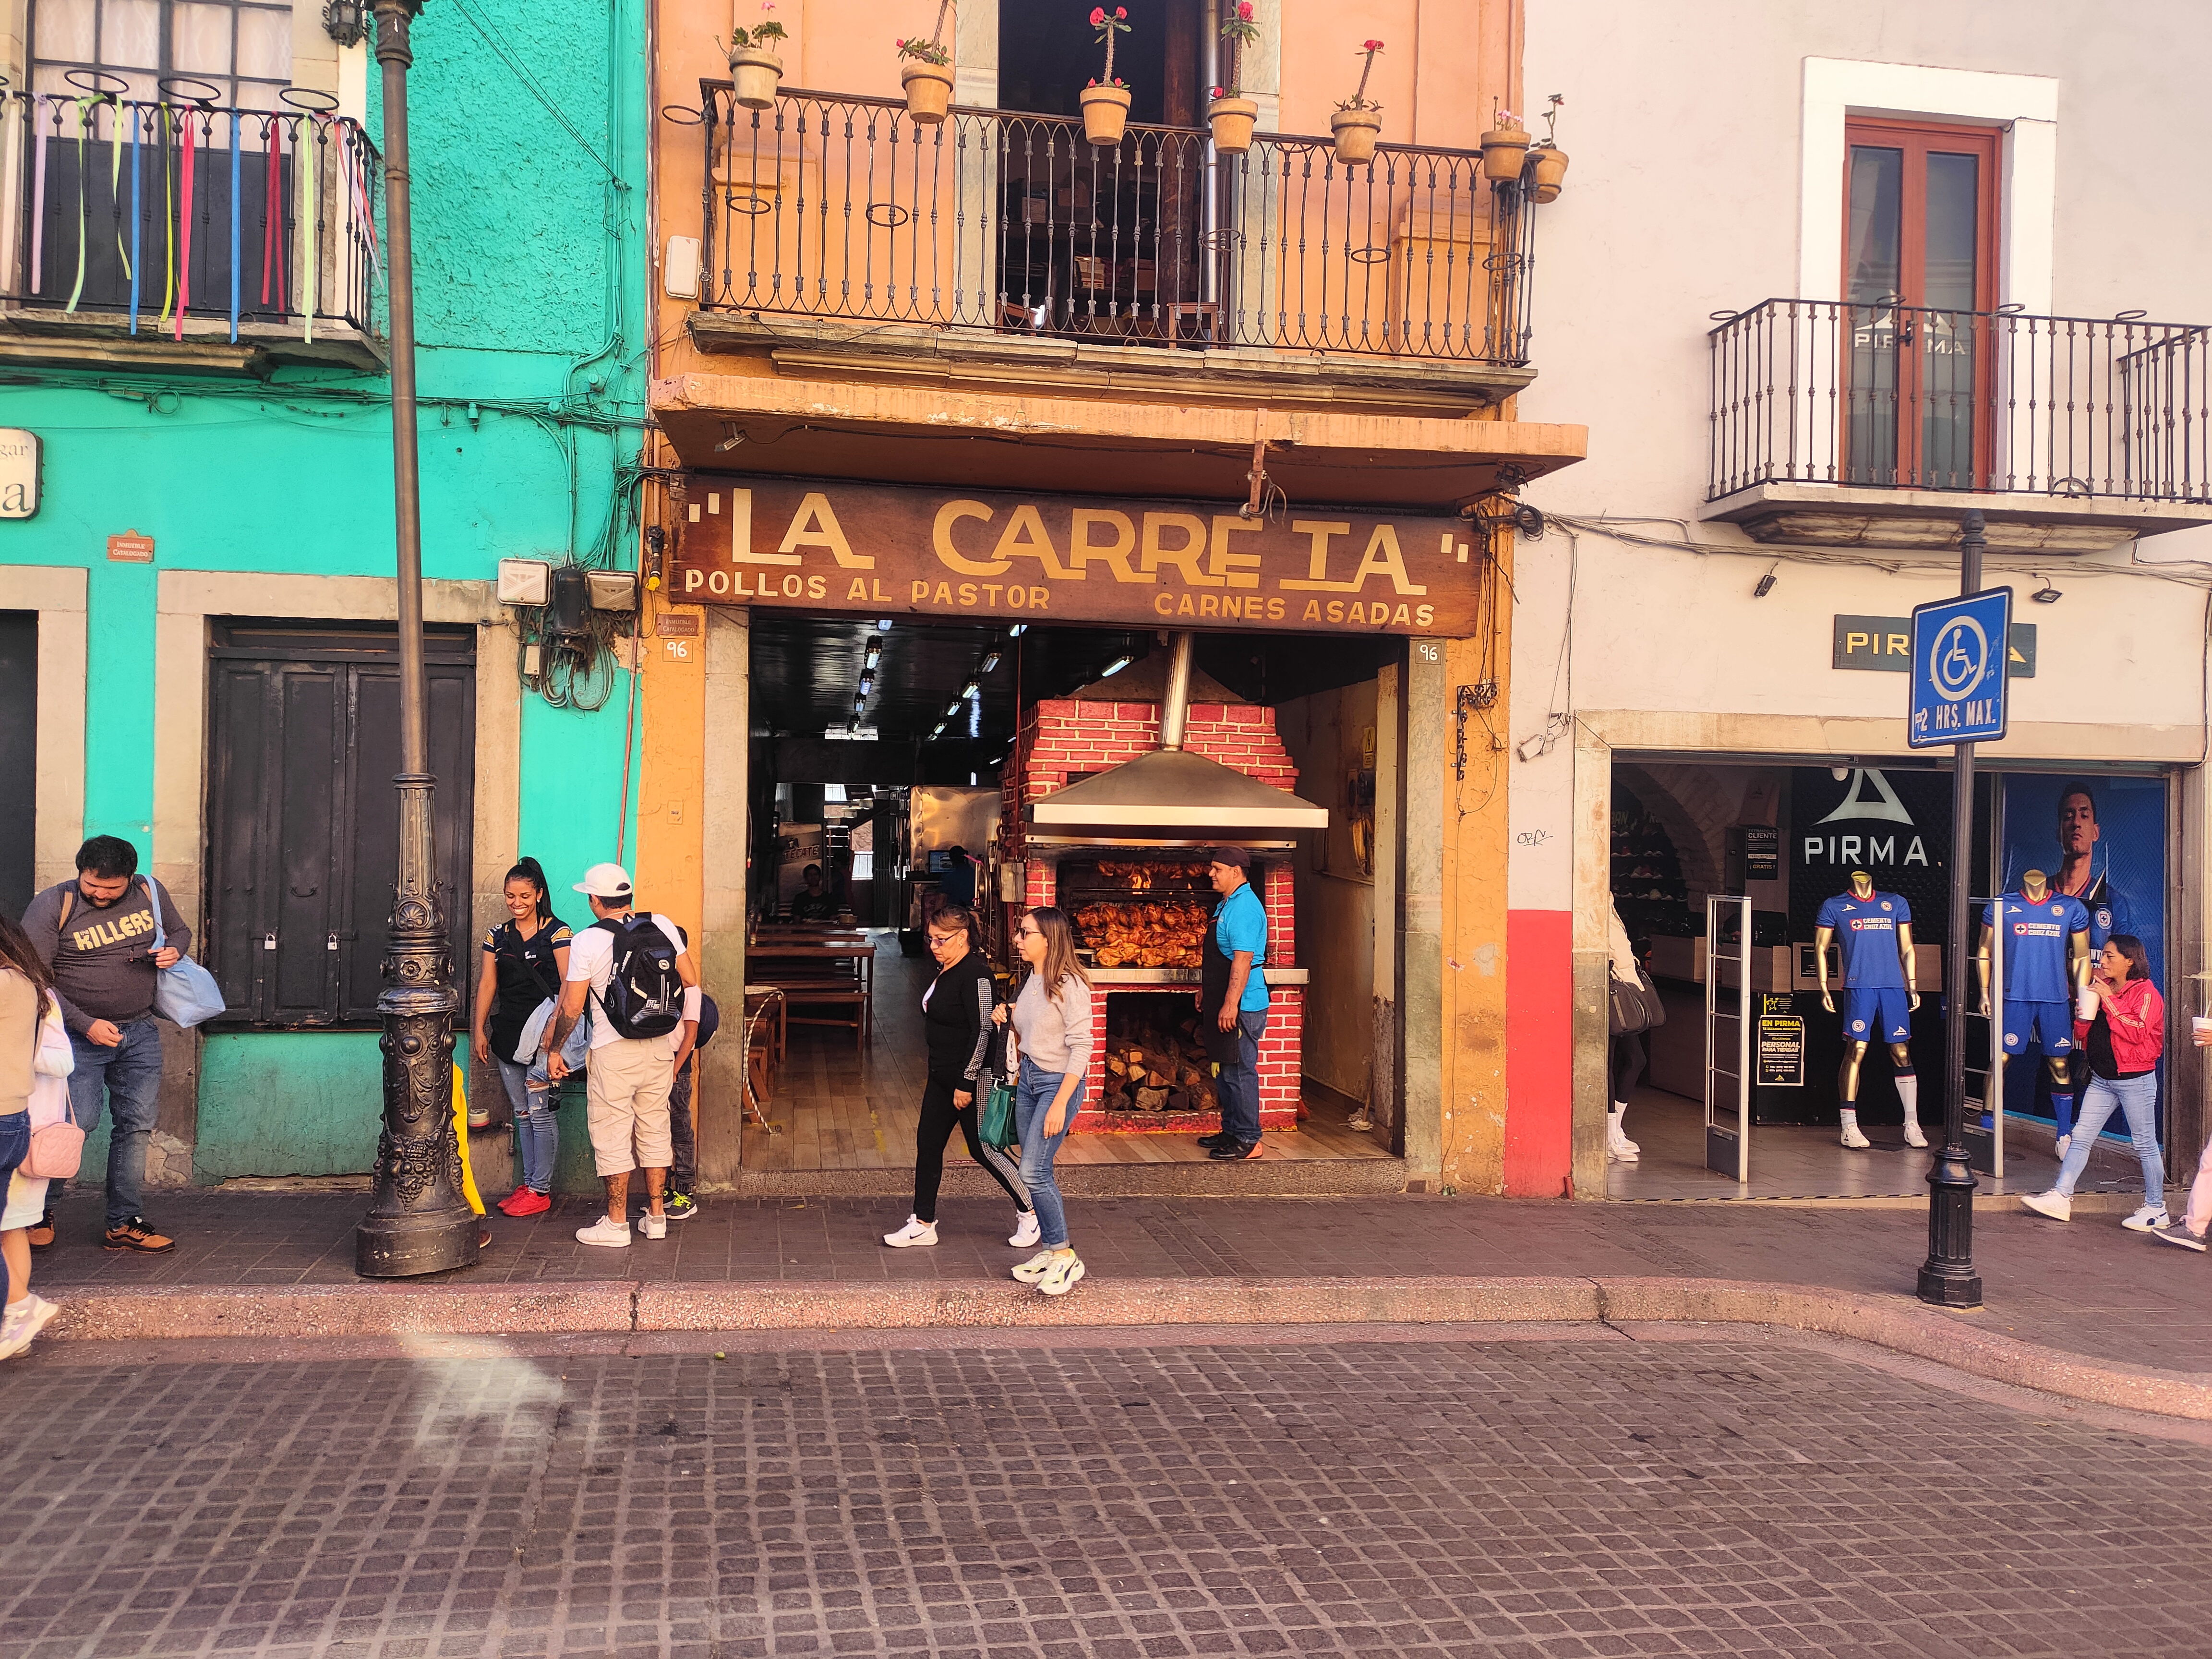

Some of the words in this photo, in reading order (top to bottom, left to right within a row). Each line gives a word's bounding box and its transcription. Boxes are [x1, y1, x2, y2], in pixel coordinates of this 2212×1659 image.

[685, 569, 827, 599] POLLOS
[847, 577, 892, 602] AL
[912, 580, 1050, 609] PASTOR
[1154, 592, 1286, 620] CARNES
[1302, 599, 1435, 627] ASADAS
[666, 641, 687, 658] 96
[1419, 644, 1438, 661] 96
[1936, 703, 1961, 730] HRS.
[1965, 698, 1996, 726] MAX.
[1805, 836, 1928, 866] PIRMA
[73, 909, 154, 950] KILLERS
